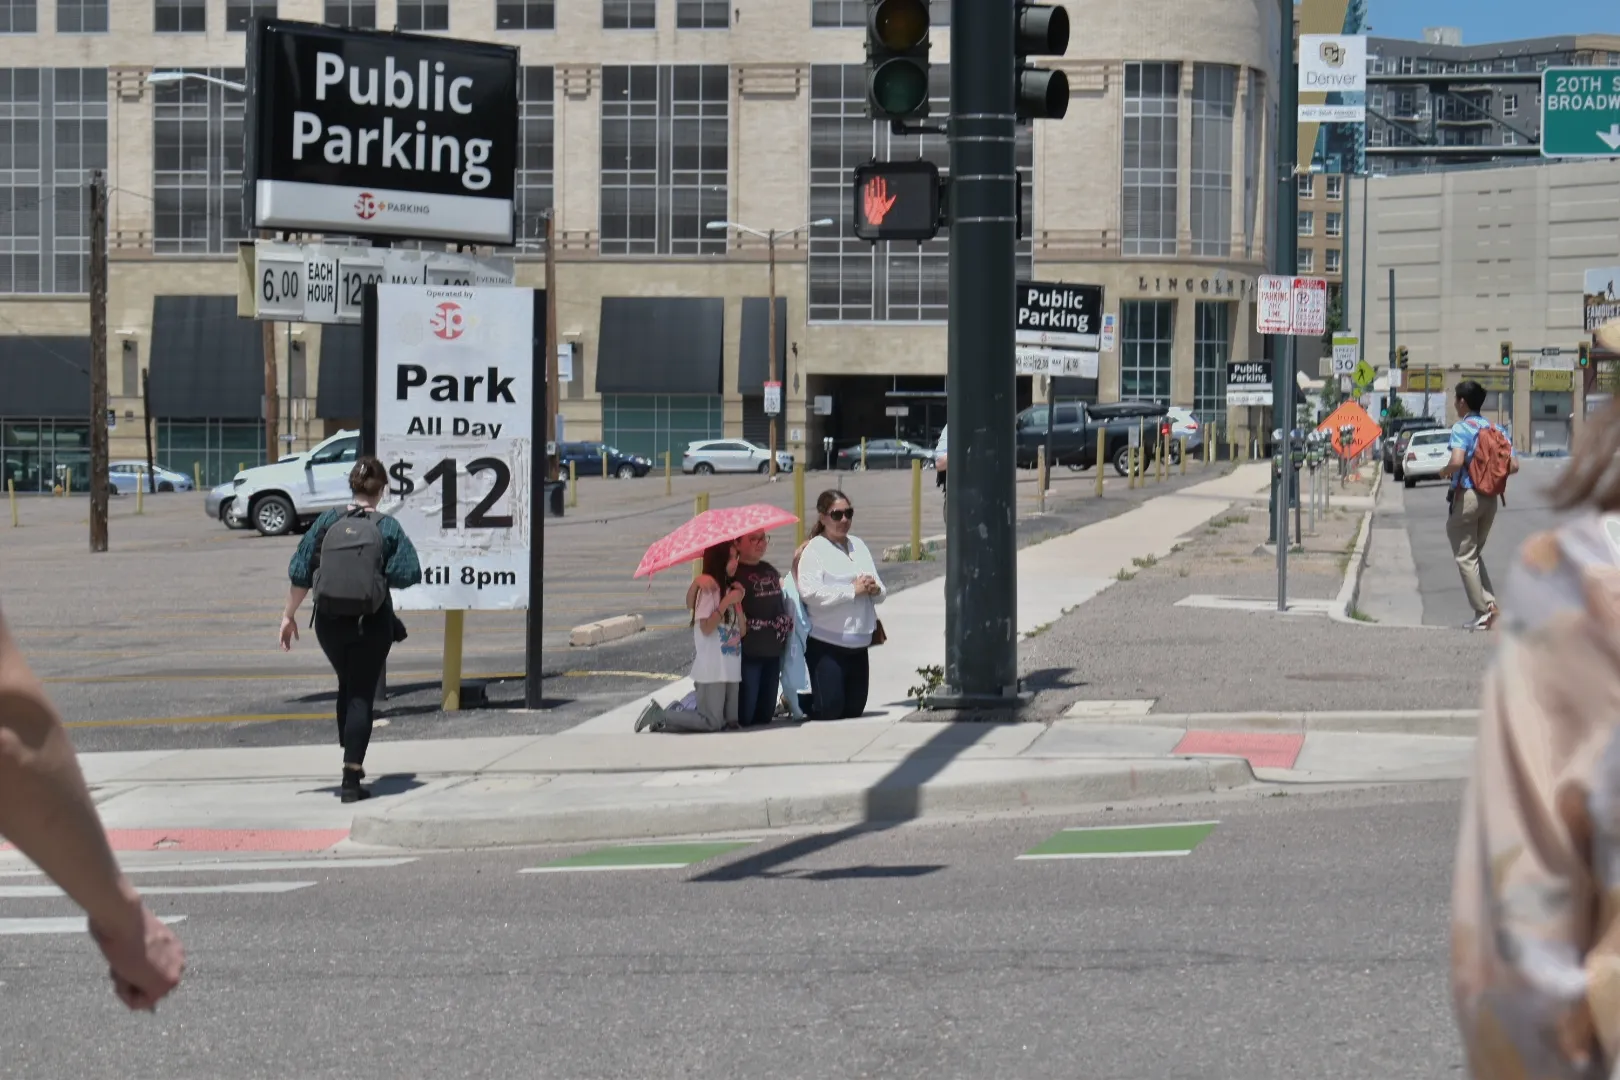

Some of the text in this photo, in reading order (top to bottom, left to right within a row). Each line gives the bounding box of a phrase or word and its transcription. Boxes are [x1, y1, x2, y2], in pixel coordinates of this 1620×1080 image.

[315, 51, 473, 114] Public
[1307, 71, 1357, 85] Denver
[1555, 76, 1602, 92] 20TH
[1547, 94, 1620, 110] BROADW
[292, 110, 493, 190] Parking
[387, 203, 430, 215] PARKING
[308, 262, 334, 281] EACH
[263, 268, 299, 303] 6.00
[307, 284, 334, 303] HOUR
[426, 289, 473, 299] Operated by
[1269, 280, 1282, 291] NO
[1027, 288, 1084, 310] Public
[1018, 307, 1090, 333] Parking
[1234, 363, 1263, 374] Public
[1335, 359, 1354, 371] 30
[396, 363, 516, 404] Park
[1230, 373, 1267, 383] Parking
[406, 416, 503, 439] All Day
[1336, 425, 1361, 434] WK
[389, 457, 514, 529] $12
[460, 566, 516, 590] 8pm
